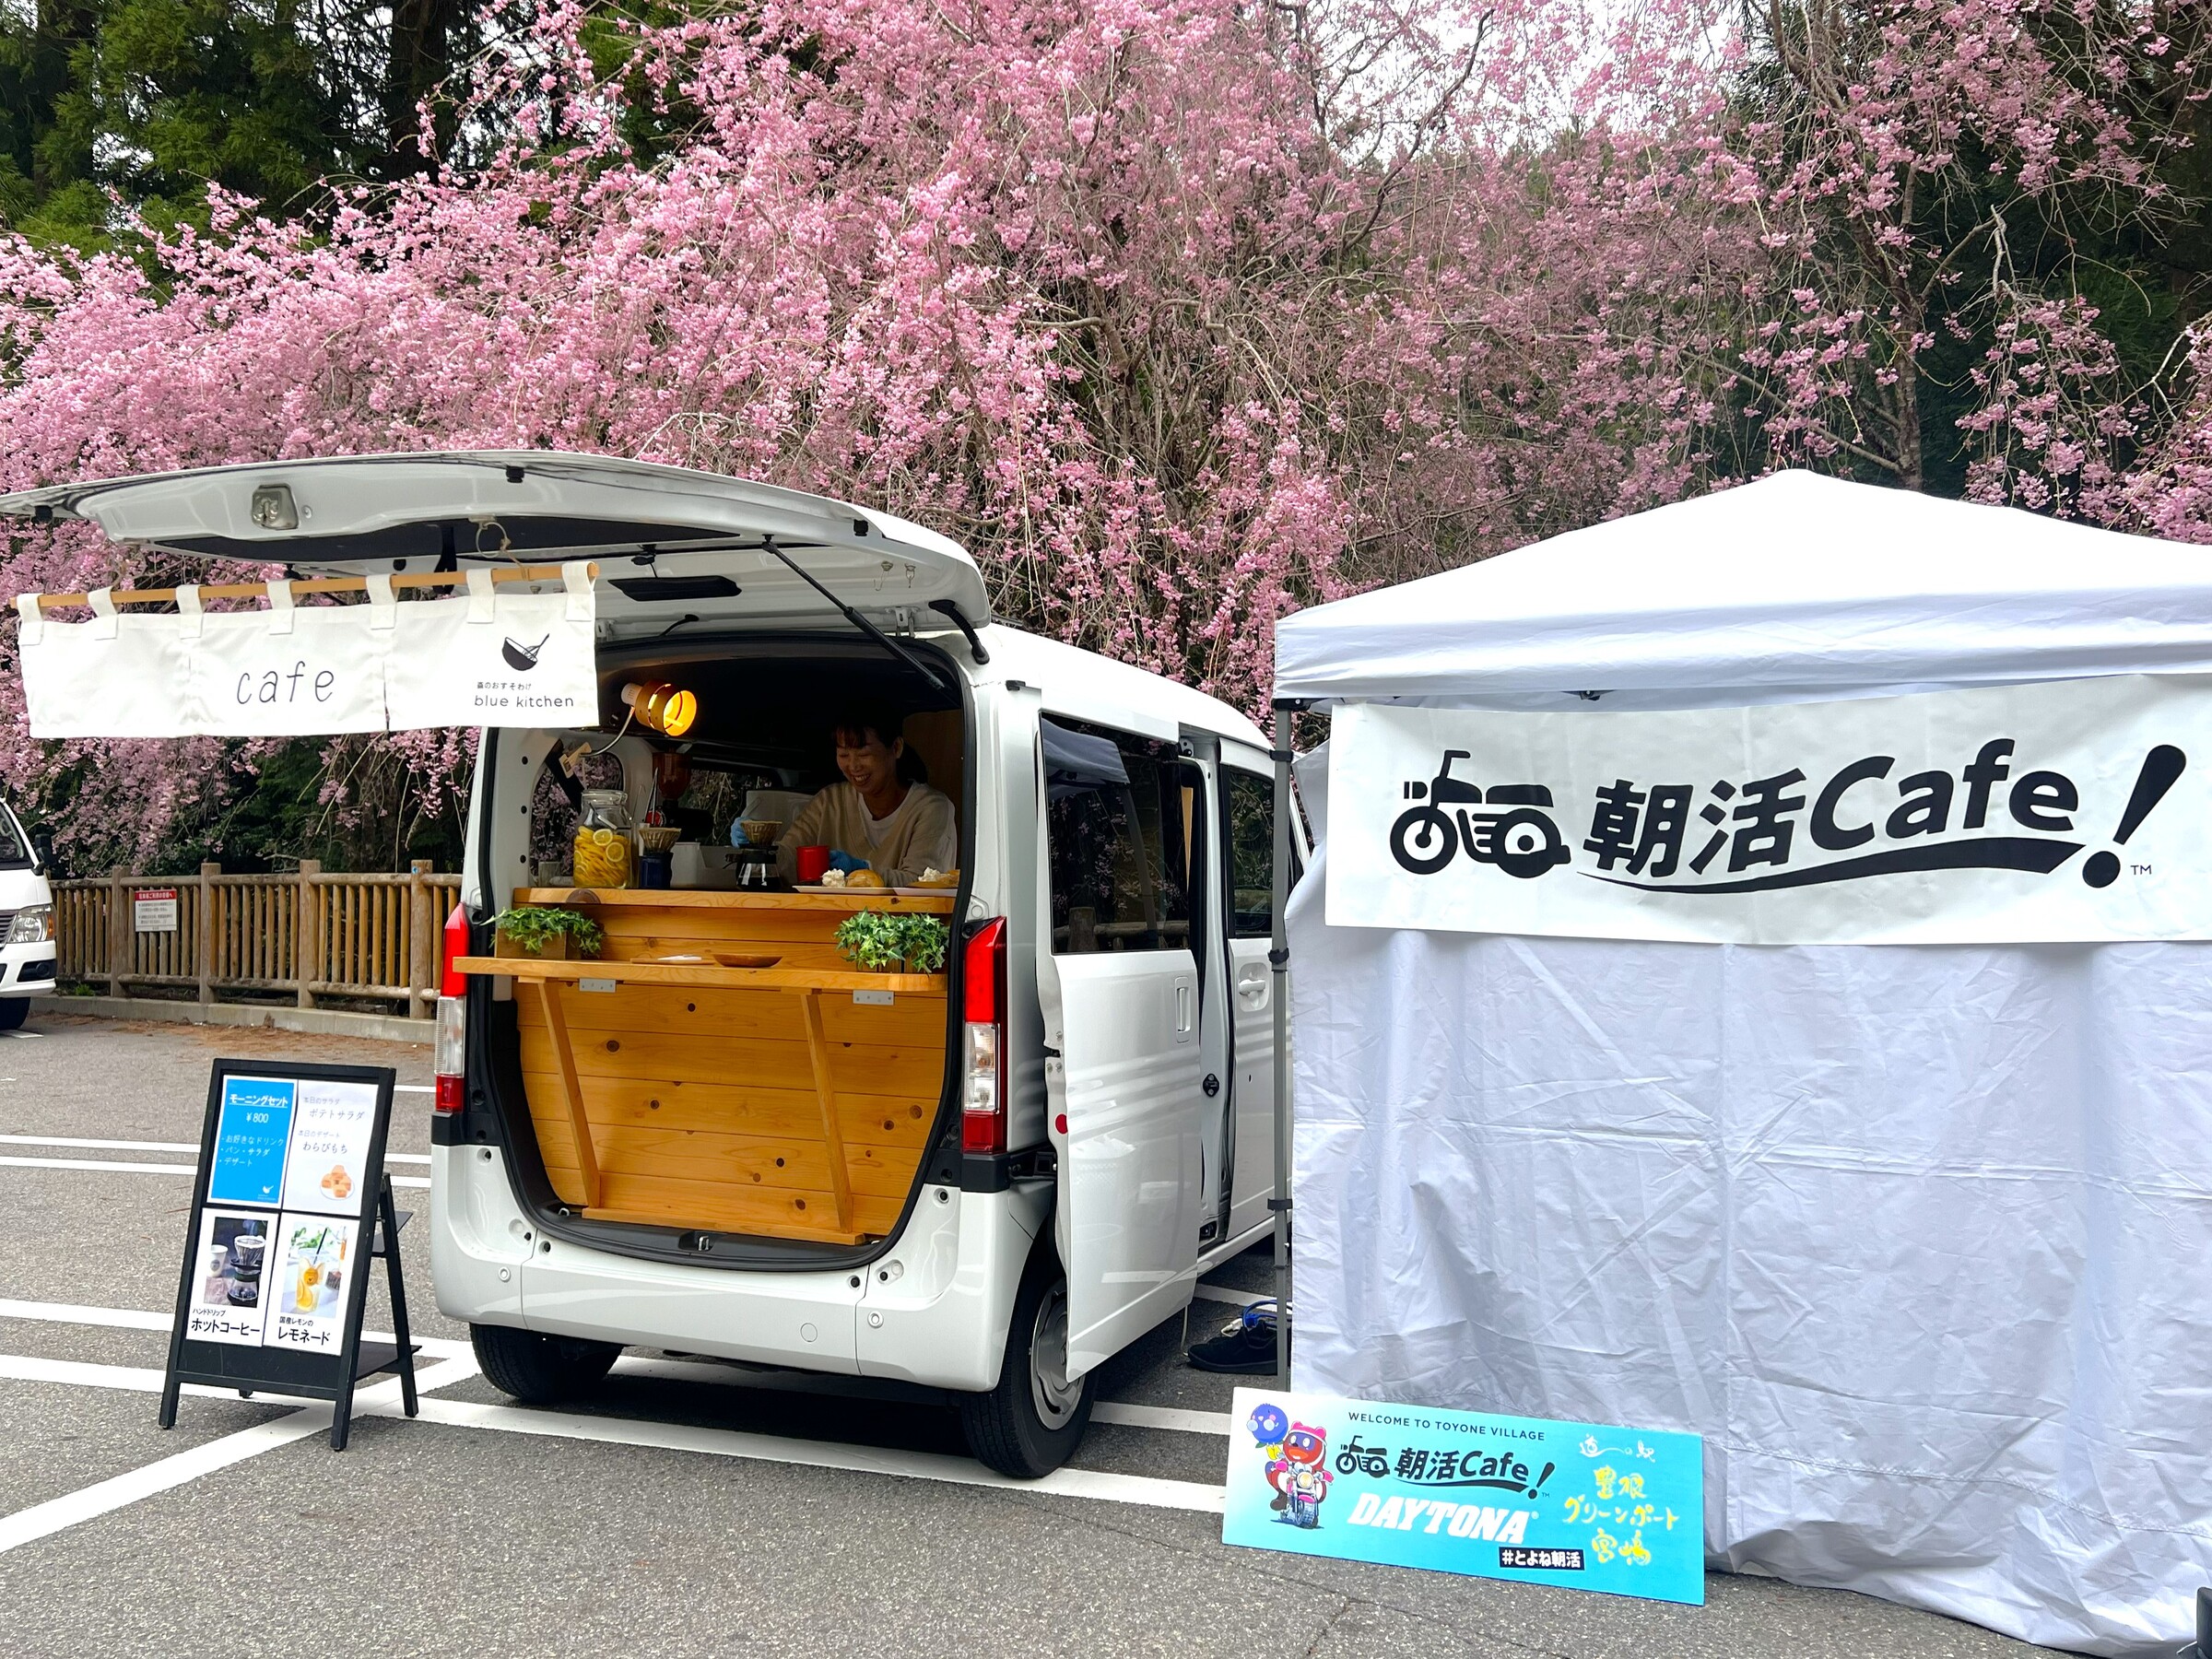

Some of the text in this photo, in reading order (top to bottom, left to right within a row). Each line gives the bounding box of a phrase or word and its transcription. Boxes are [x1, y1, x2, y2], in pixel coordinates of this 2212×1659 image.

[236, 660, 335, 706] cafe
[474, 694, 574, 708] blue kitchen
[229, 1093, 288, 1107] モーニングセット
[245, 1112, 269, 1124] ¥800
[309, 1108, 366, 1122] ポテトサラダ
[302, 1141, 347, 1155] わらびもち
[192, 1307, 227, 1317] ハンドドリップ
[278, 1315, 314, 1327] 国産レモンの
[191, 1317, 261, 1336] ホットコーヒー
[277, 1325, 332, 1347] レモネード
[1347, 1411, 1546, 1441] WELCOME TO TOYONE VILLAGE
[1593, 1464, 1648, 1500] 豊根
[1347, 1491, 1530, 1545] DAYTONA
[1562, 1494, 1680, 1532] グリーンポート
[1500, 1549, 1582, 1569] #とよね朝活
